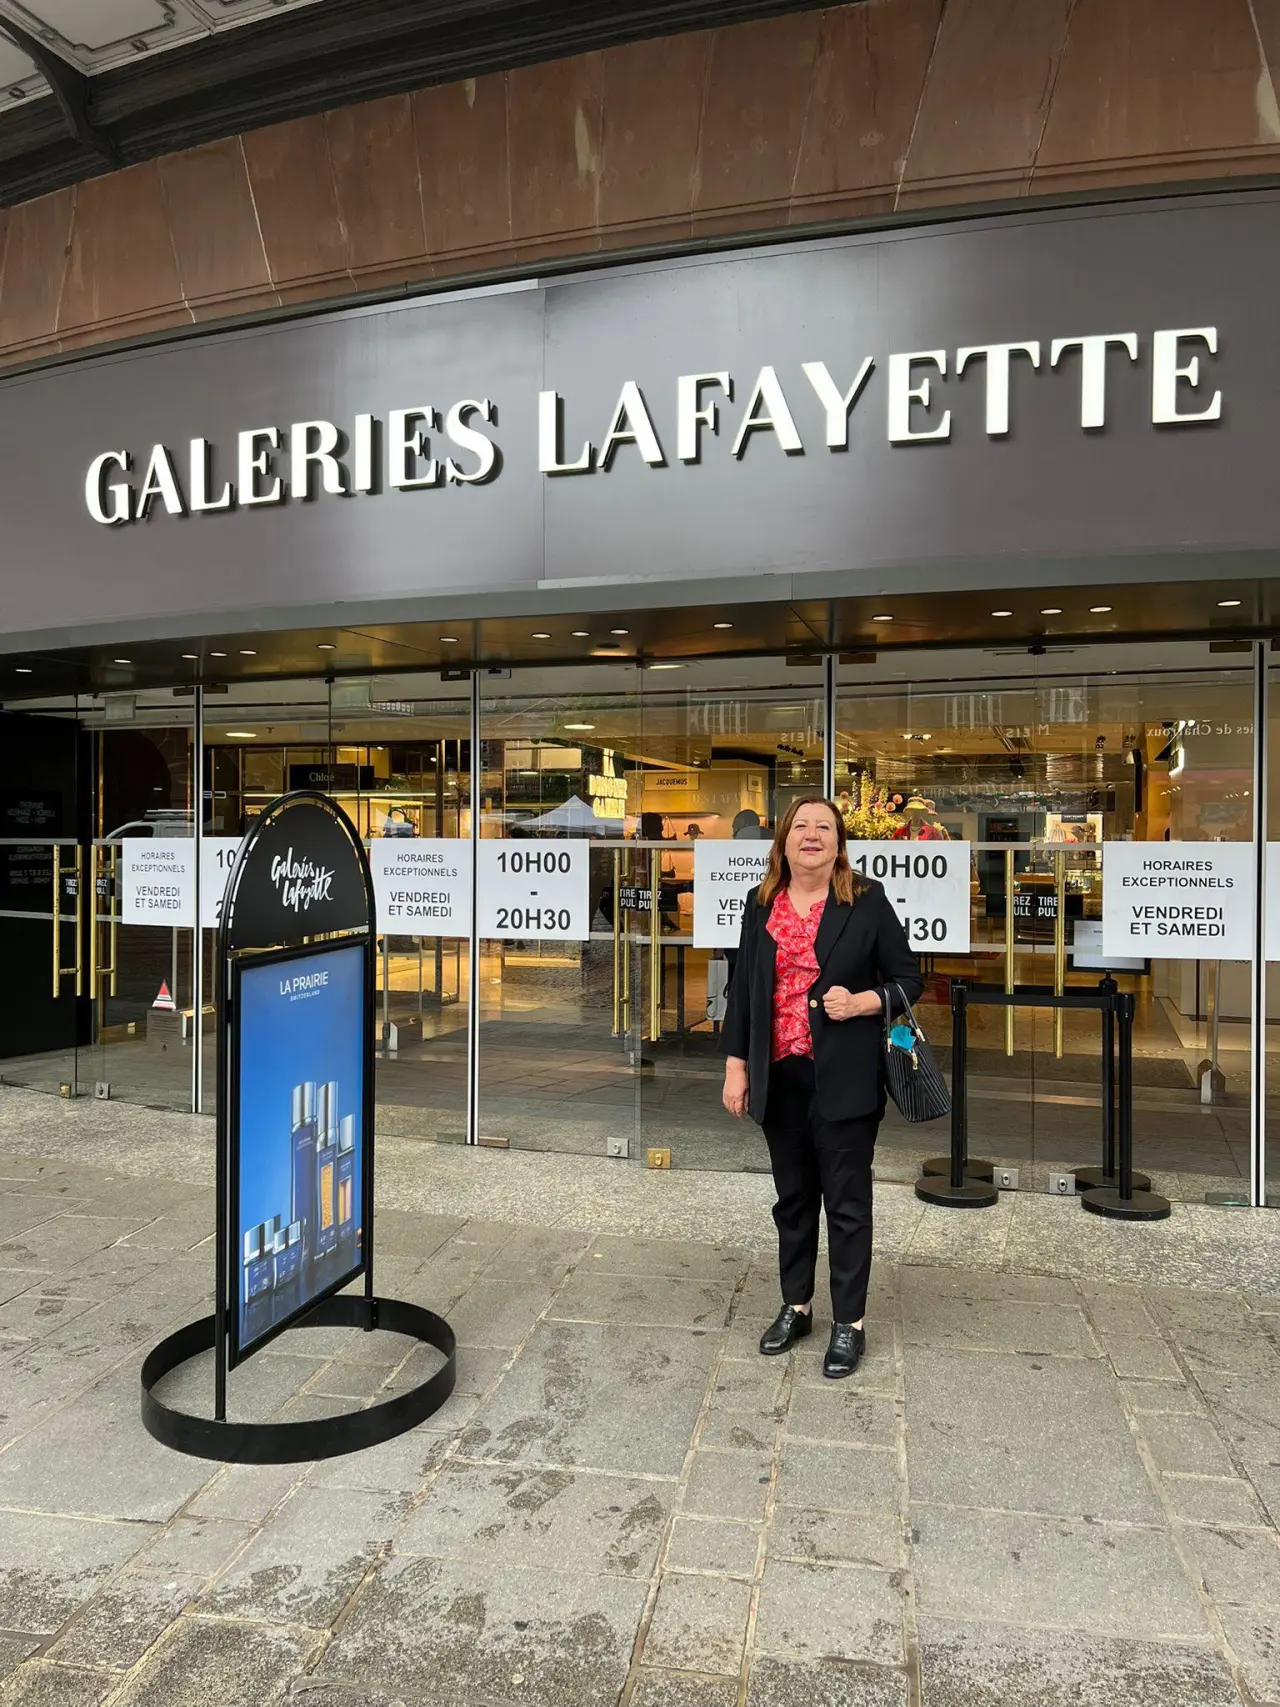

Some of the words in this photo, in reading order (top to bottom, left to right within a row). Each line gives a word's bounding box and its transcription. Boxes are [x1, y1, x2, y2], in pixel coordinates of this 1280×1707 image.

[85, 399, 499, 525] GALERIES
[538, 326, 1223, 473] LAFAYETTE
[656, 778, 688, 786] JACQUEMUS
[141, 852, 175, 860] HORAIRES
[397, 853, 444, 863] HORAIRES
[131, 864, 185, 873] EXCEPTIONNELS
[497, 851, 571, 874] 10H00
[856, 854, 949, 879] 10H00
[1143, 860, 1213, 872] HORAIRES
[383, 867, 458, 877] EXCEPTIONNELS
[1122, 876, 1234, 888] EXCEPTIONNELS
[136, 885, 180, 897] VENDREDI
[619, 888, 637, 898] TIRE
[135, 897, 146, 908] ET
[148, 898, 181, 910] SAMEDI
[389, 891, 450, 904] VENDREDI
[620, 898, 637, 908] PUL
[1038, 896, 1059, 906] TIRE
[388, 904, 403, 916] ET
[406, 905, 452, 917] SAMEDI
[1013, 906, 1031, 916] ULL
[1038, 907, 1057, 917] PUL
[1132, 905, 1223, 920] VENDREDI
[496, 907, 571, 931] 20H30
[717, 913, 736, 926] ET
[1130, 922, 1152, 935] ET
[1156, 922, 1225, 937] SAMEDI
[280, 980, 292, 996] LA
[293, 971, 329, 992] PRAIRIE
